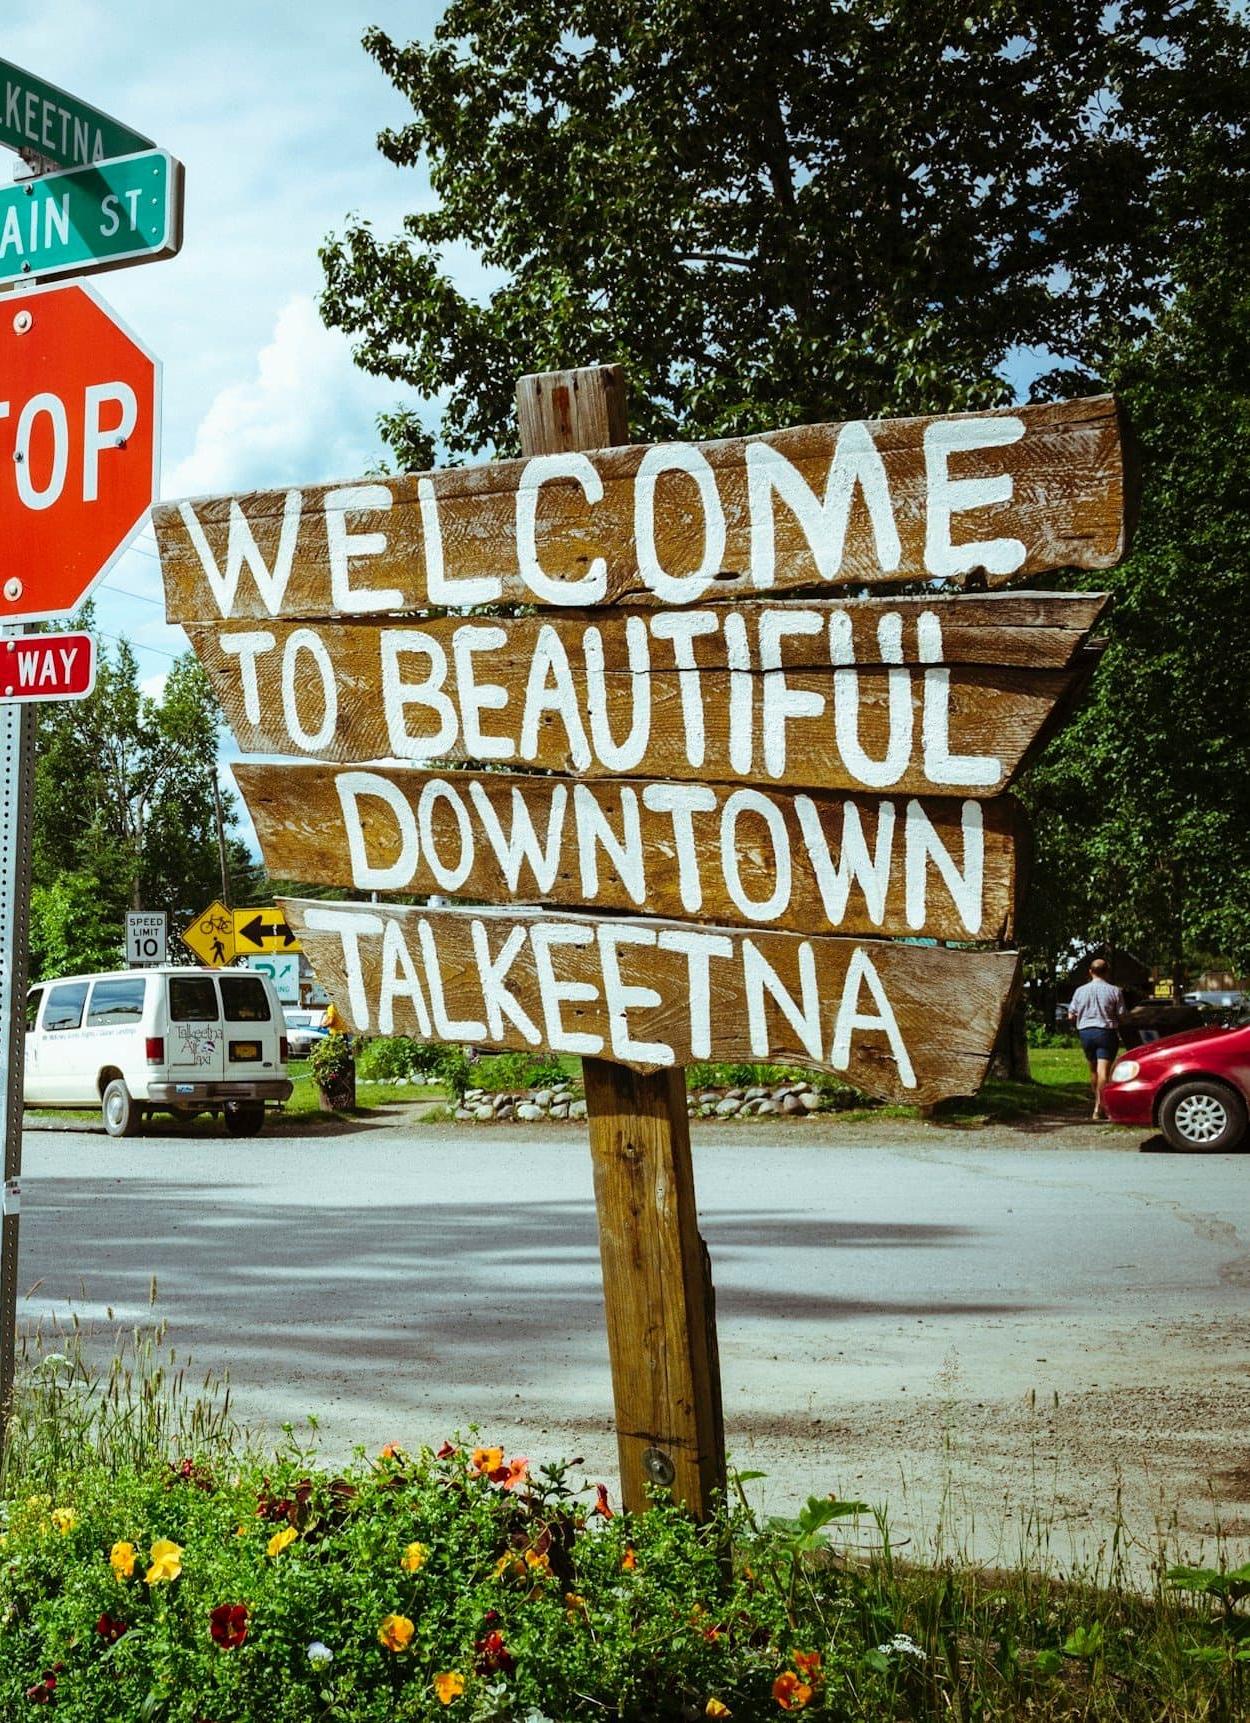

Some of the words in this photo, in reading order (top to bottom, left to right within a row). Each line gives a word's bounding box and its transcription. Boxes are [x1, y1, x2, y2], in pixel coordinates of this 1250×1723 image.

[99, 188, 143, 237] ST
[178, 416, 1027, 619] WELCOME
[17, 647, 79, 687] WAY
[218, 628, 338, 753] TO
[380, 609, 1002, 787] BEAUTIFUL
[334, 772, 985, 935] DOWNTOWN
[130, 918, 163, 926] SPEED
[133, 928, 159, 936] LIMIT
[134, 938, 158, 957] 10
[303, 908, 918, 1089] TALKEETNA
[175, 1023, 223, 1041] Talkeetna
[181, 1040, 200, 1053] Air
